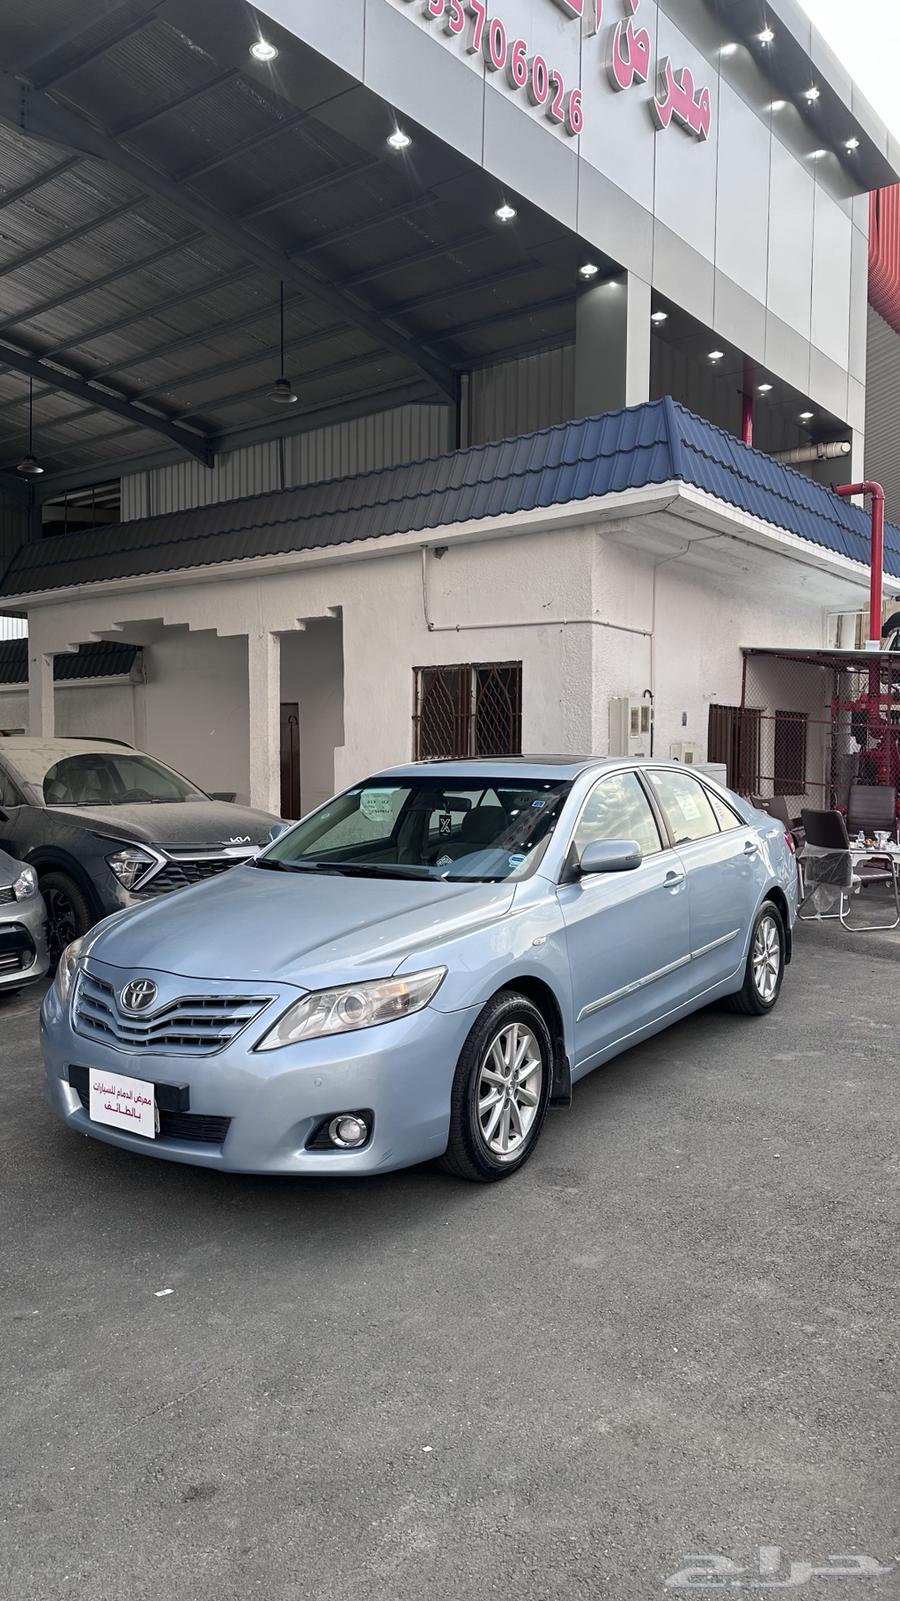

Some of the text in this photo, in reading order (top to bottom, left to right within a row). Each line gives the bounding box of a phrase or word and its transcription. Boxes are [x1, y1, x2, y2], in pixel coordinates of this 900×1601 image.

[93, 1082, 152, 1106] معرض الدمام للسيارات
[104, 1101, 142, 1122] بالطائف
